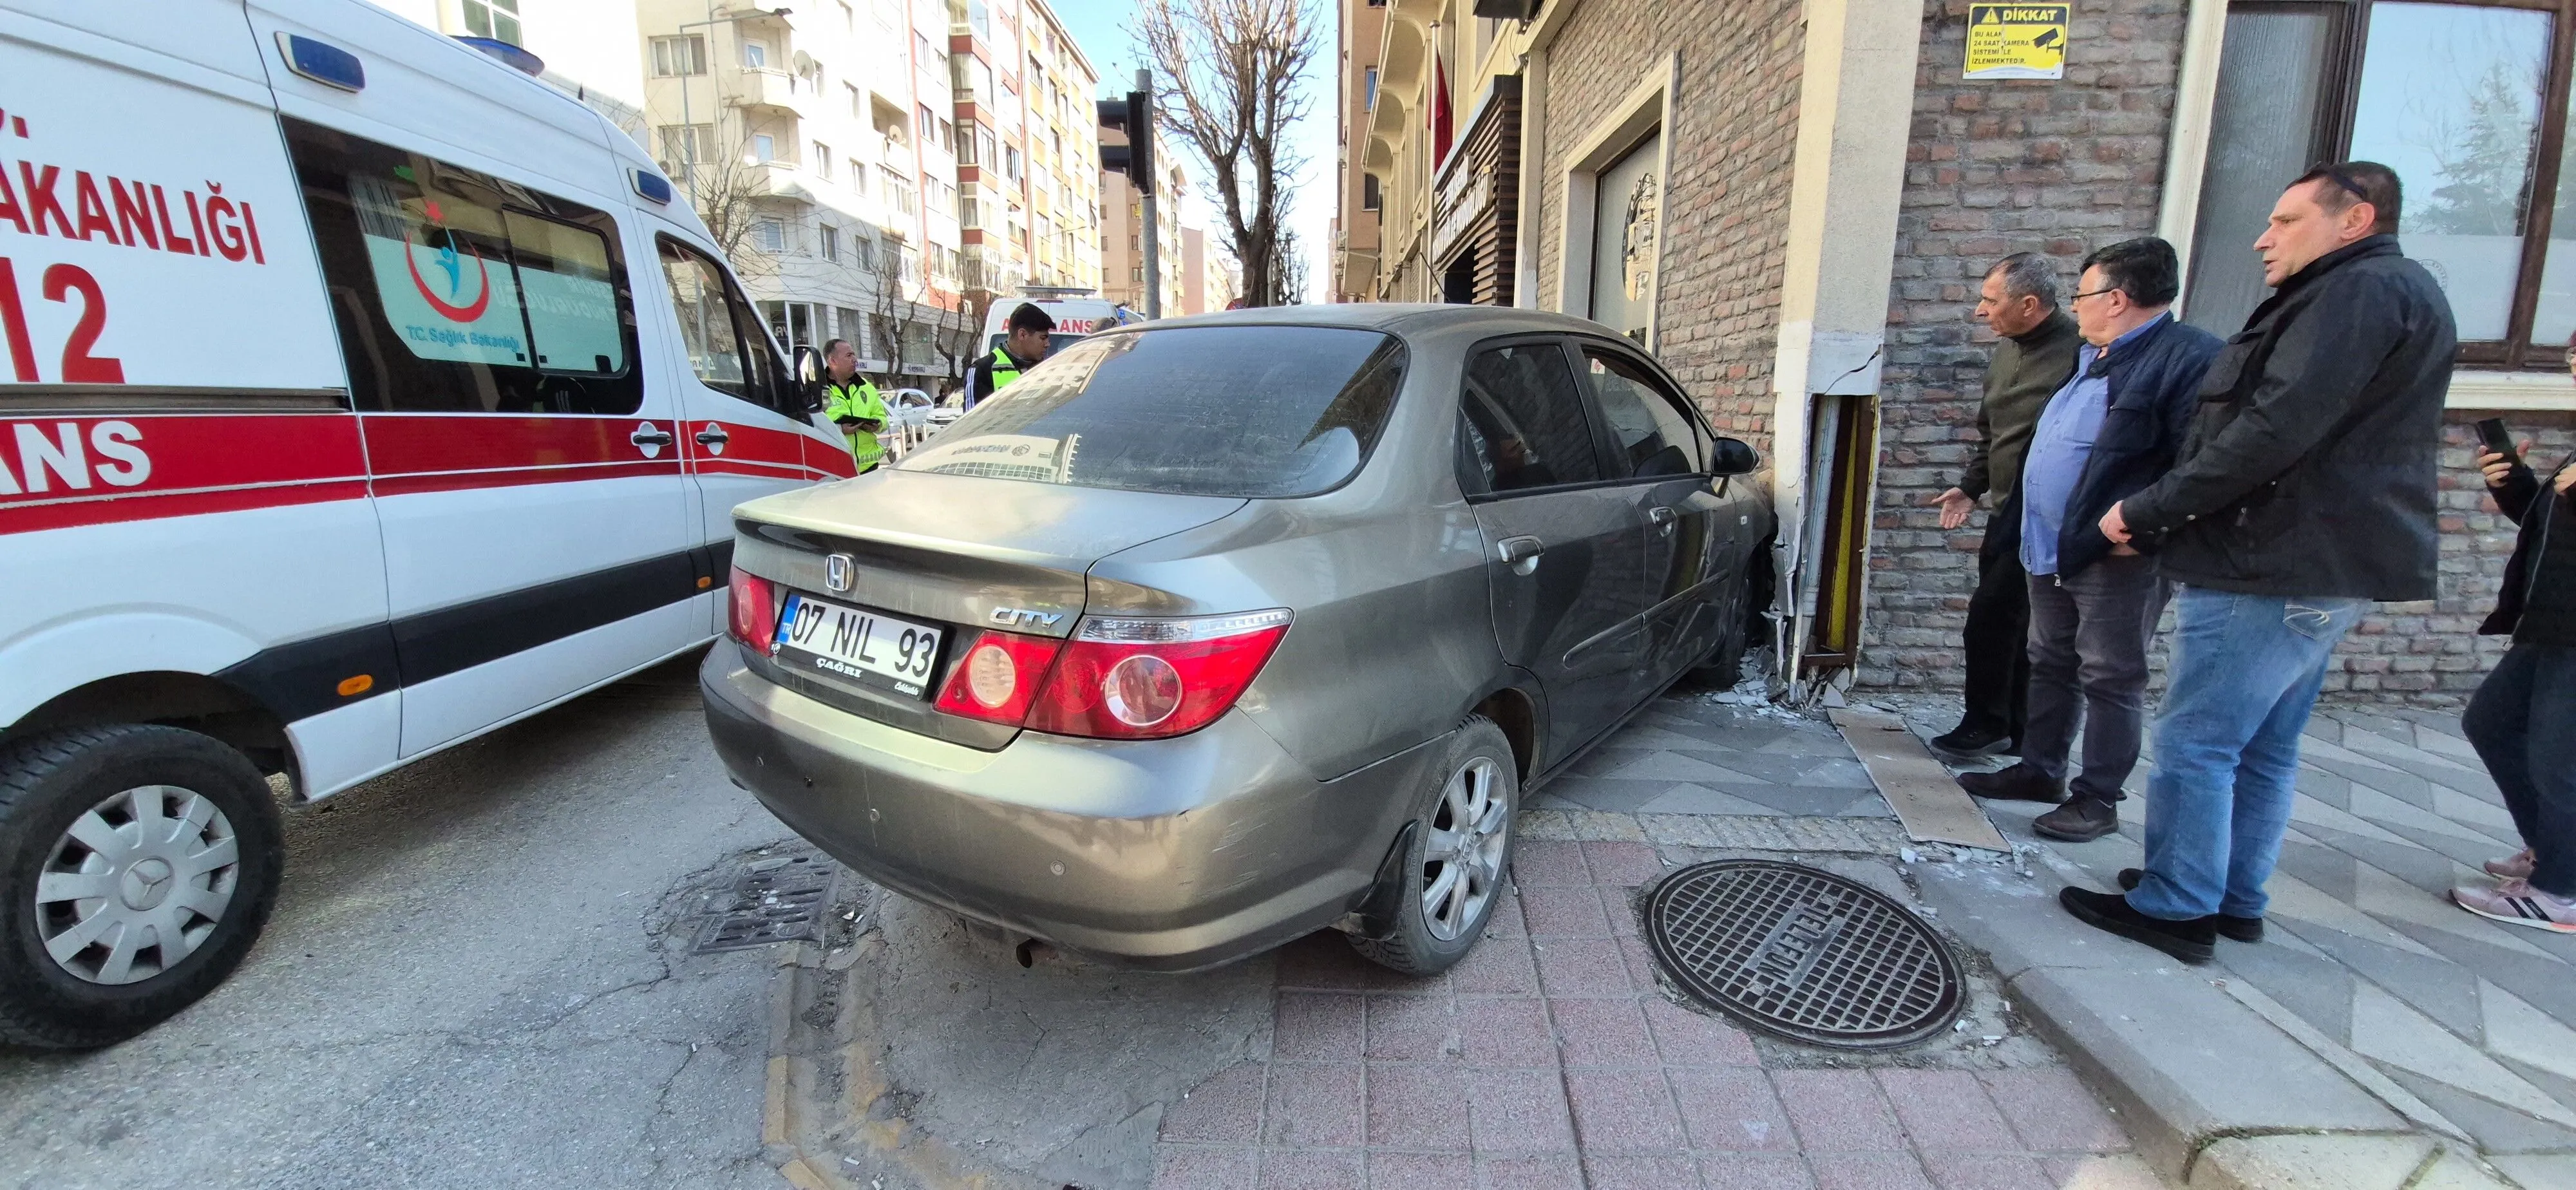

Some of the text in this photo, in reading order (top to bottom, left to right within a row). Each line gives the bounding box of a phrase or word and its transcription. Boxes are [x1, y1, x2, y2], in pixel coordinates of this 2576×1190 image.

[2002, 6, 2058, 22] DİKKAT
[990, 607, 1064, 629] CITY
[782, 622, 792, 636] TR
[791, 602, 935, 677] 07 NIL 93
[816, 657, 863, 678] ÇAĞRI
[1755, 906, 1833, 981] TELEFON
